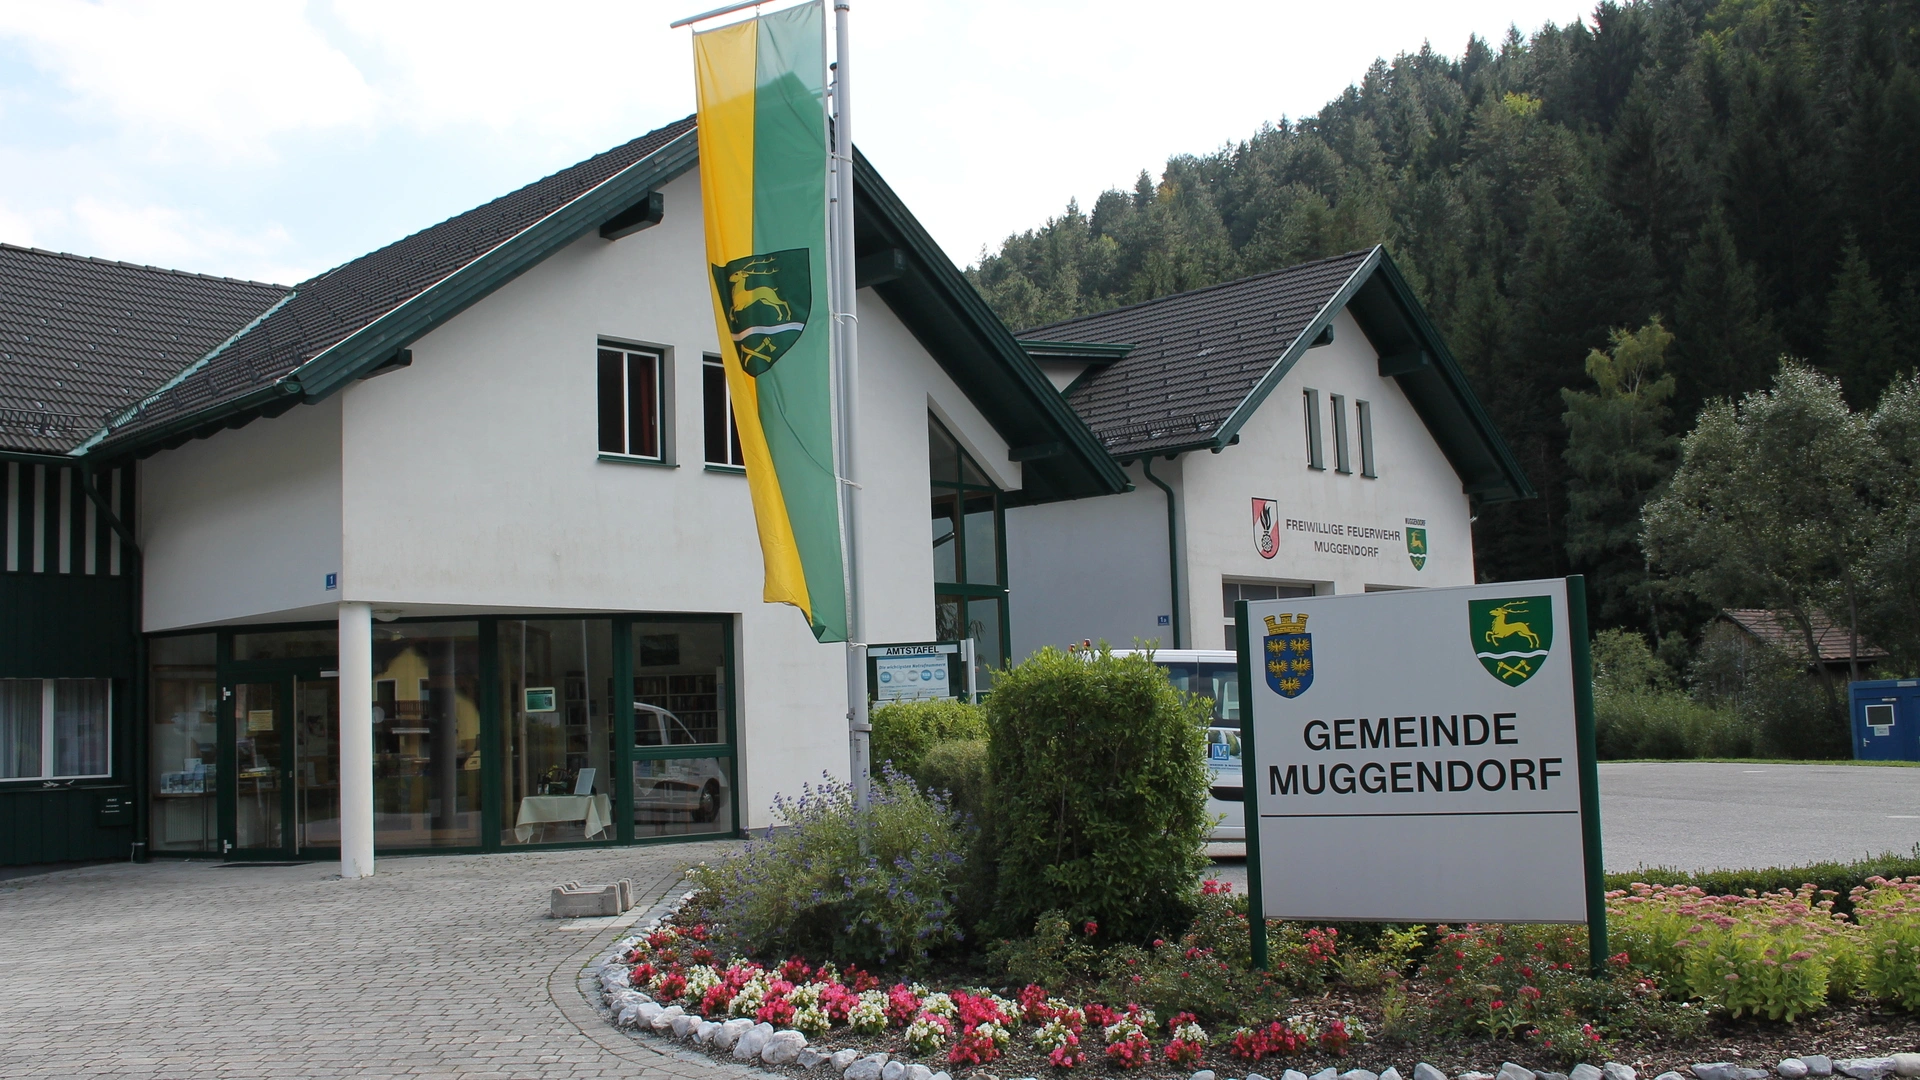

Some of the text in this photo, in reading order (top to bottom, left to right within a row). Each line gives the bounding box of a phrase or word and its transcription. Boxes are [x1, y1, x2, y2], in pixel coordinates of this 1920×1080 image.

[1286, 519, 1401, 541] FREIWILLIGE FEUERWEHR
[1405, 518, 1426, 526] MUGGENDORF
[1314, 541, 1379, 557] MUGGENDORF
[886, 646, 939, 655] AMTSTAFEL
[1304, 713, 1518, 751] GEMEINDE
[1269, 758, 1562, 795] MUGGENDORF
